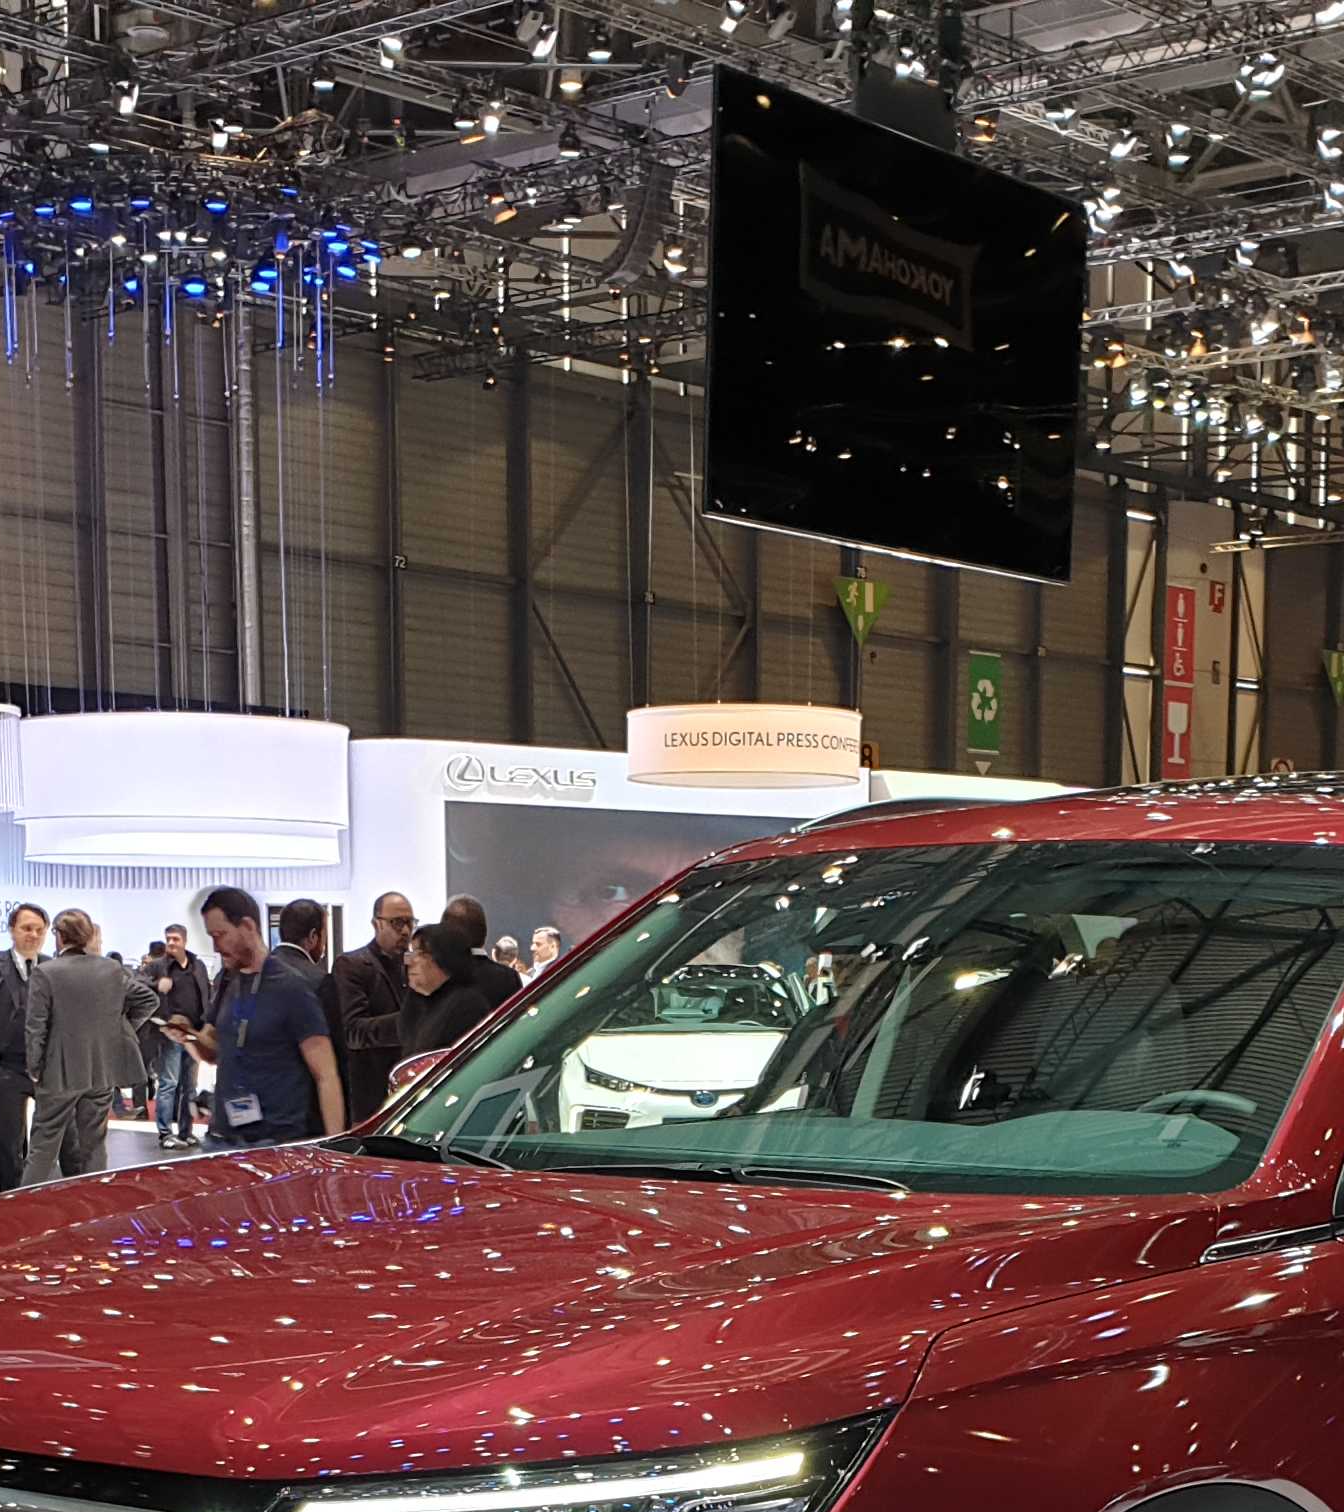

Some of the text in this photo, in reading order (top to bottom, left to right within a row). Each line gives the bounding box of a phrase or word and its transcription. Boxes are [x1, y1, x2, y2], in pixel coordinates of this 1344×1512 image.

[664, 731, 709, 748] LEXUS
[712, 731, 774, 747] DIGITAL
[777, 732, 819, 749] PRESS
[489, 765, 596, 790] LEXUS
